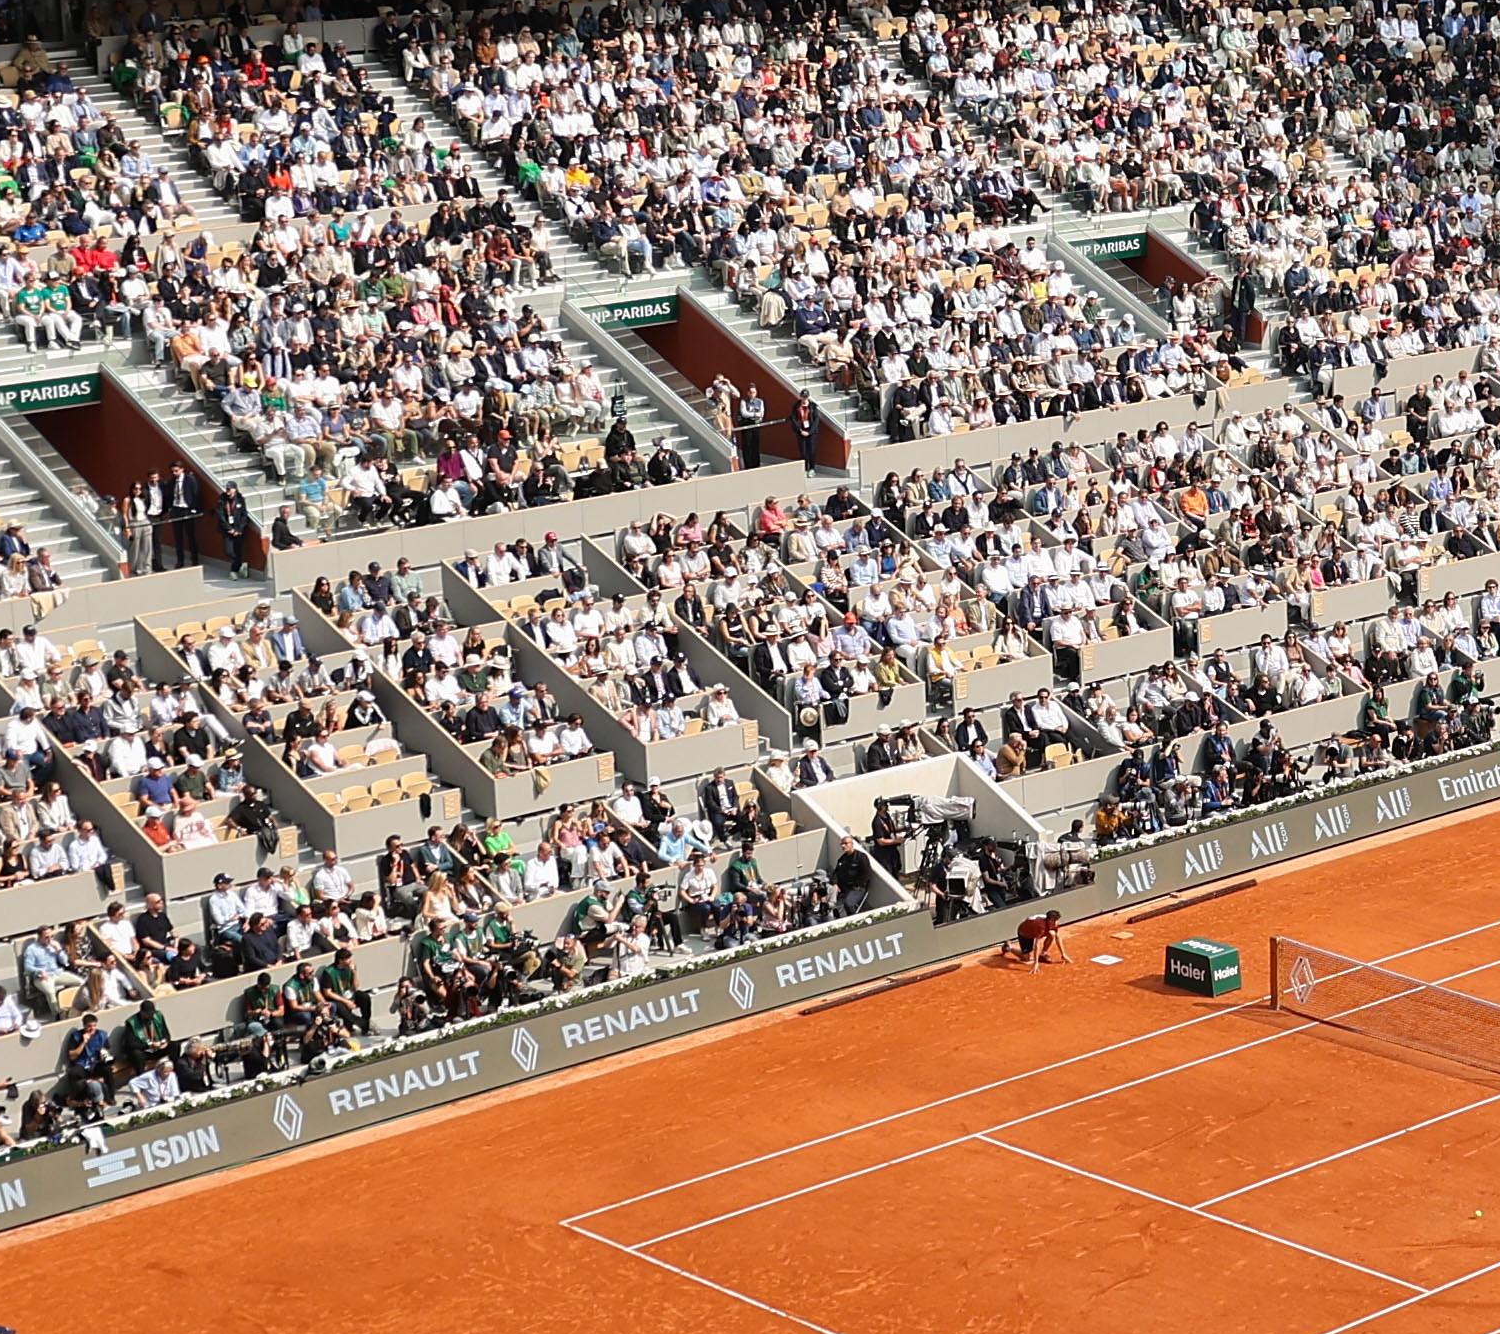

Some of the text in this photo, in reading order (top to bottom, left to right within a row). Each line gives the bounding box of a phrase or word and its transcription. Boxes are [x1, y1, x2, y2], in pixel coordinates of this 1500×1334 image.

[1093, 238, 1141, 256] PARIBAS
[614, 301, 671, 322] PARIBAS
[20, 381, 92, 405] PARIBAS
[1170, 958, 1206, 982] Haier
[1213, 965, 1239, 982] Haier
[329, 932, 905, 1117] RENAULT RENAULT RENAULT
[142, 1125, 220, 1173] ISDIN
